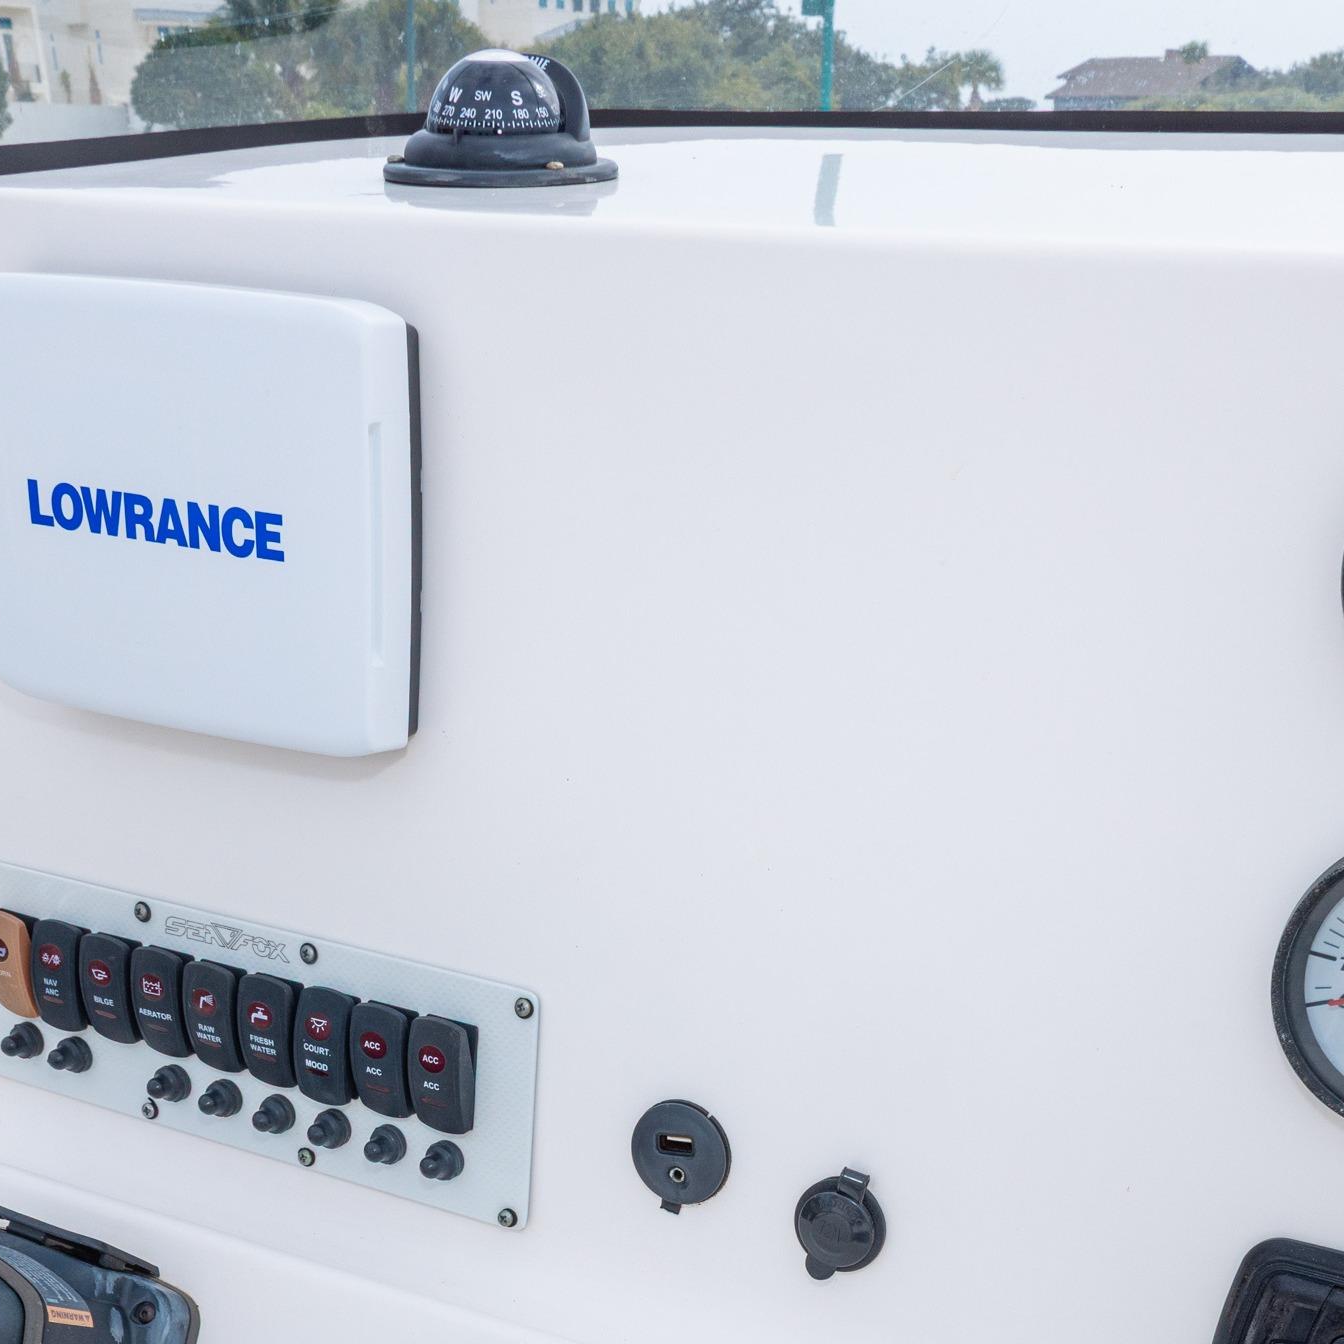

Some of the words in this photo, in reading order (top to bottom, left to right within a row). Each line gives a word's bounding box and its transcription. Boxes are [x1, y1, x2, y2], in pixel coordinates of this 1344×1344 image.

[449, 87, 463, 103] W
[475, 90, 492, 101] SW
[511, 90, 523, 105] S
[442, 106, 454, 117] 270
[460, 108, 476, 118] 240
[485, 109, 503, 120] 210
[513, 109, 529, 119] 180
[536, 107, 549, 117] 150
[27, 478, 285, 562] LOWRANCE
[44, 978, 57, 986] NAV
[45, 987, 59, 996] ANC
[93, 995, 114, 1006] BILGE
[139, 1007, 172, 1021] AERATOR
[198, 1023, 214, 1033] RAW
[196, 1031, 222, 1043] WATER
[249, 1035, 274, 1046] FRESH
[250, 1043, 277, 1056] WATER
[303, 1043, 331, 1057] COURT.
[364, 1040, 381, 1051] ACC
[305, 1059, 328, 1071] MOOD
[422, 1054, 439, 1065] ACC
[366, 1066, 382, 1076] ACC
[423, 1080, 440, 1091] ACC
